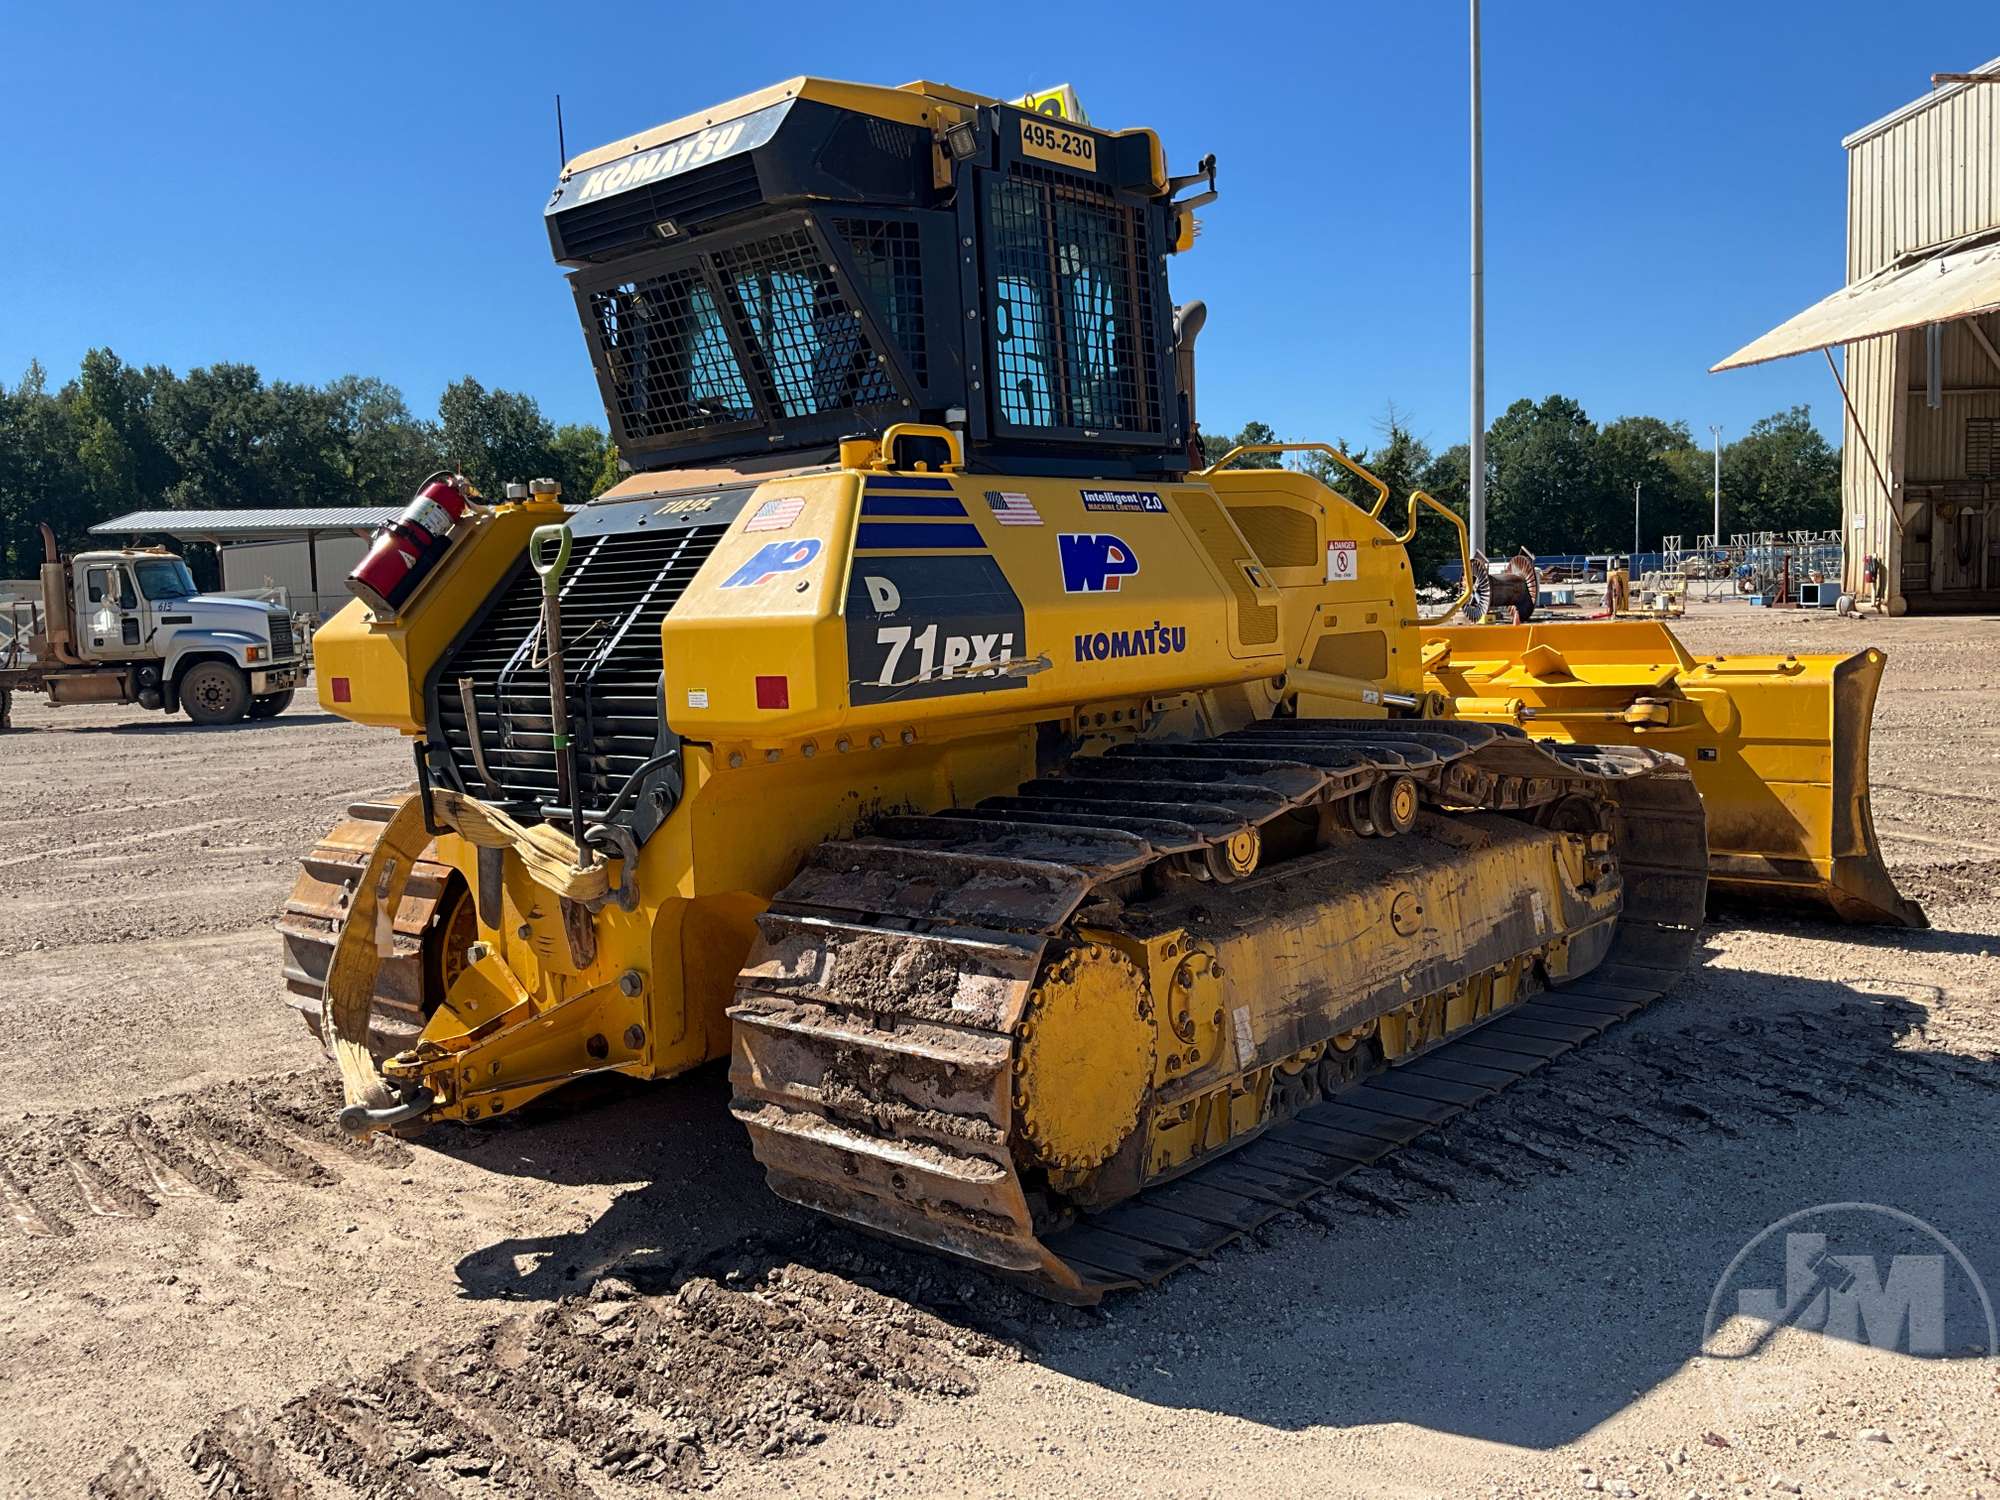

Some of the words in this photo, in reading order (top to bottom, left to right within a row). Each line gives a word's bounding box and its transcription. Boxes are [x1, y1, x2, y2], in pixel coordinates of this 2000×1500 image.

[1023, 123, 1093, 160] 495-230
[578, 122, 746, 200] KOMATSU
[1142, 496, 1162, 510] 2.0
[1334, 541, 1356, 549] DANGER
[1075, 620, 1186, 662] KOMATSU
